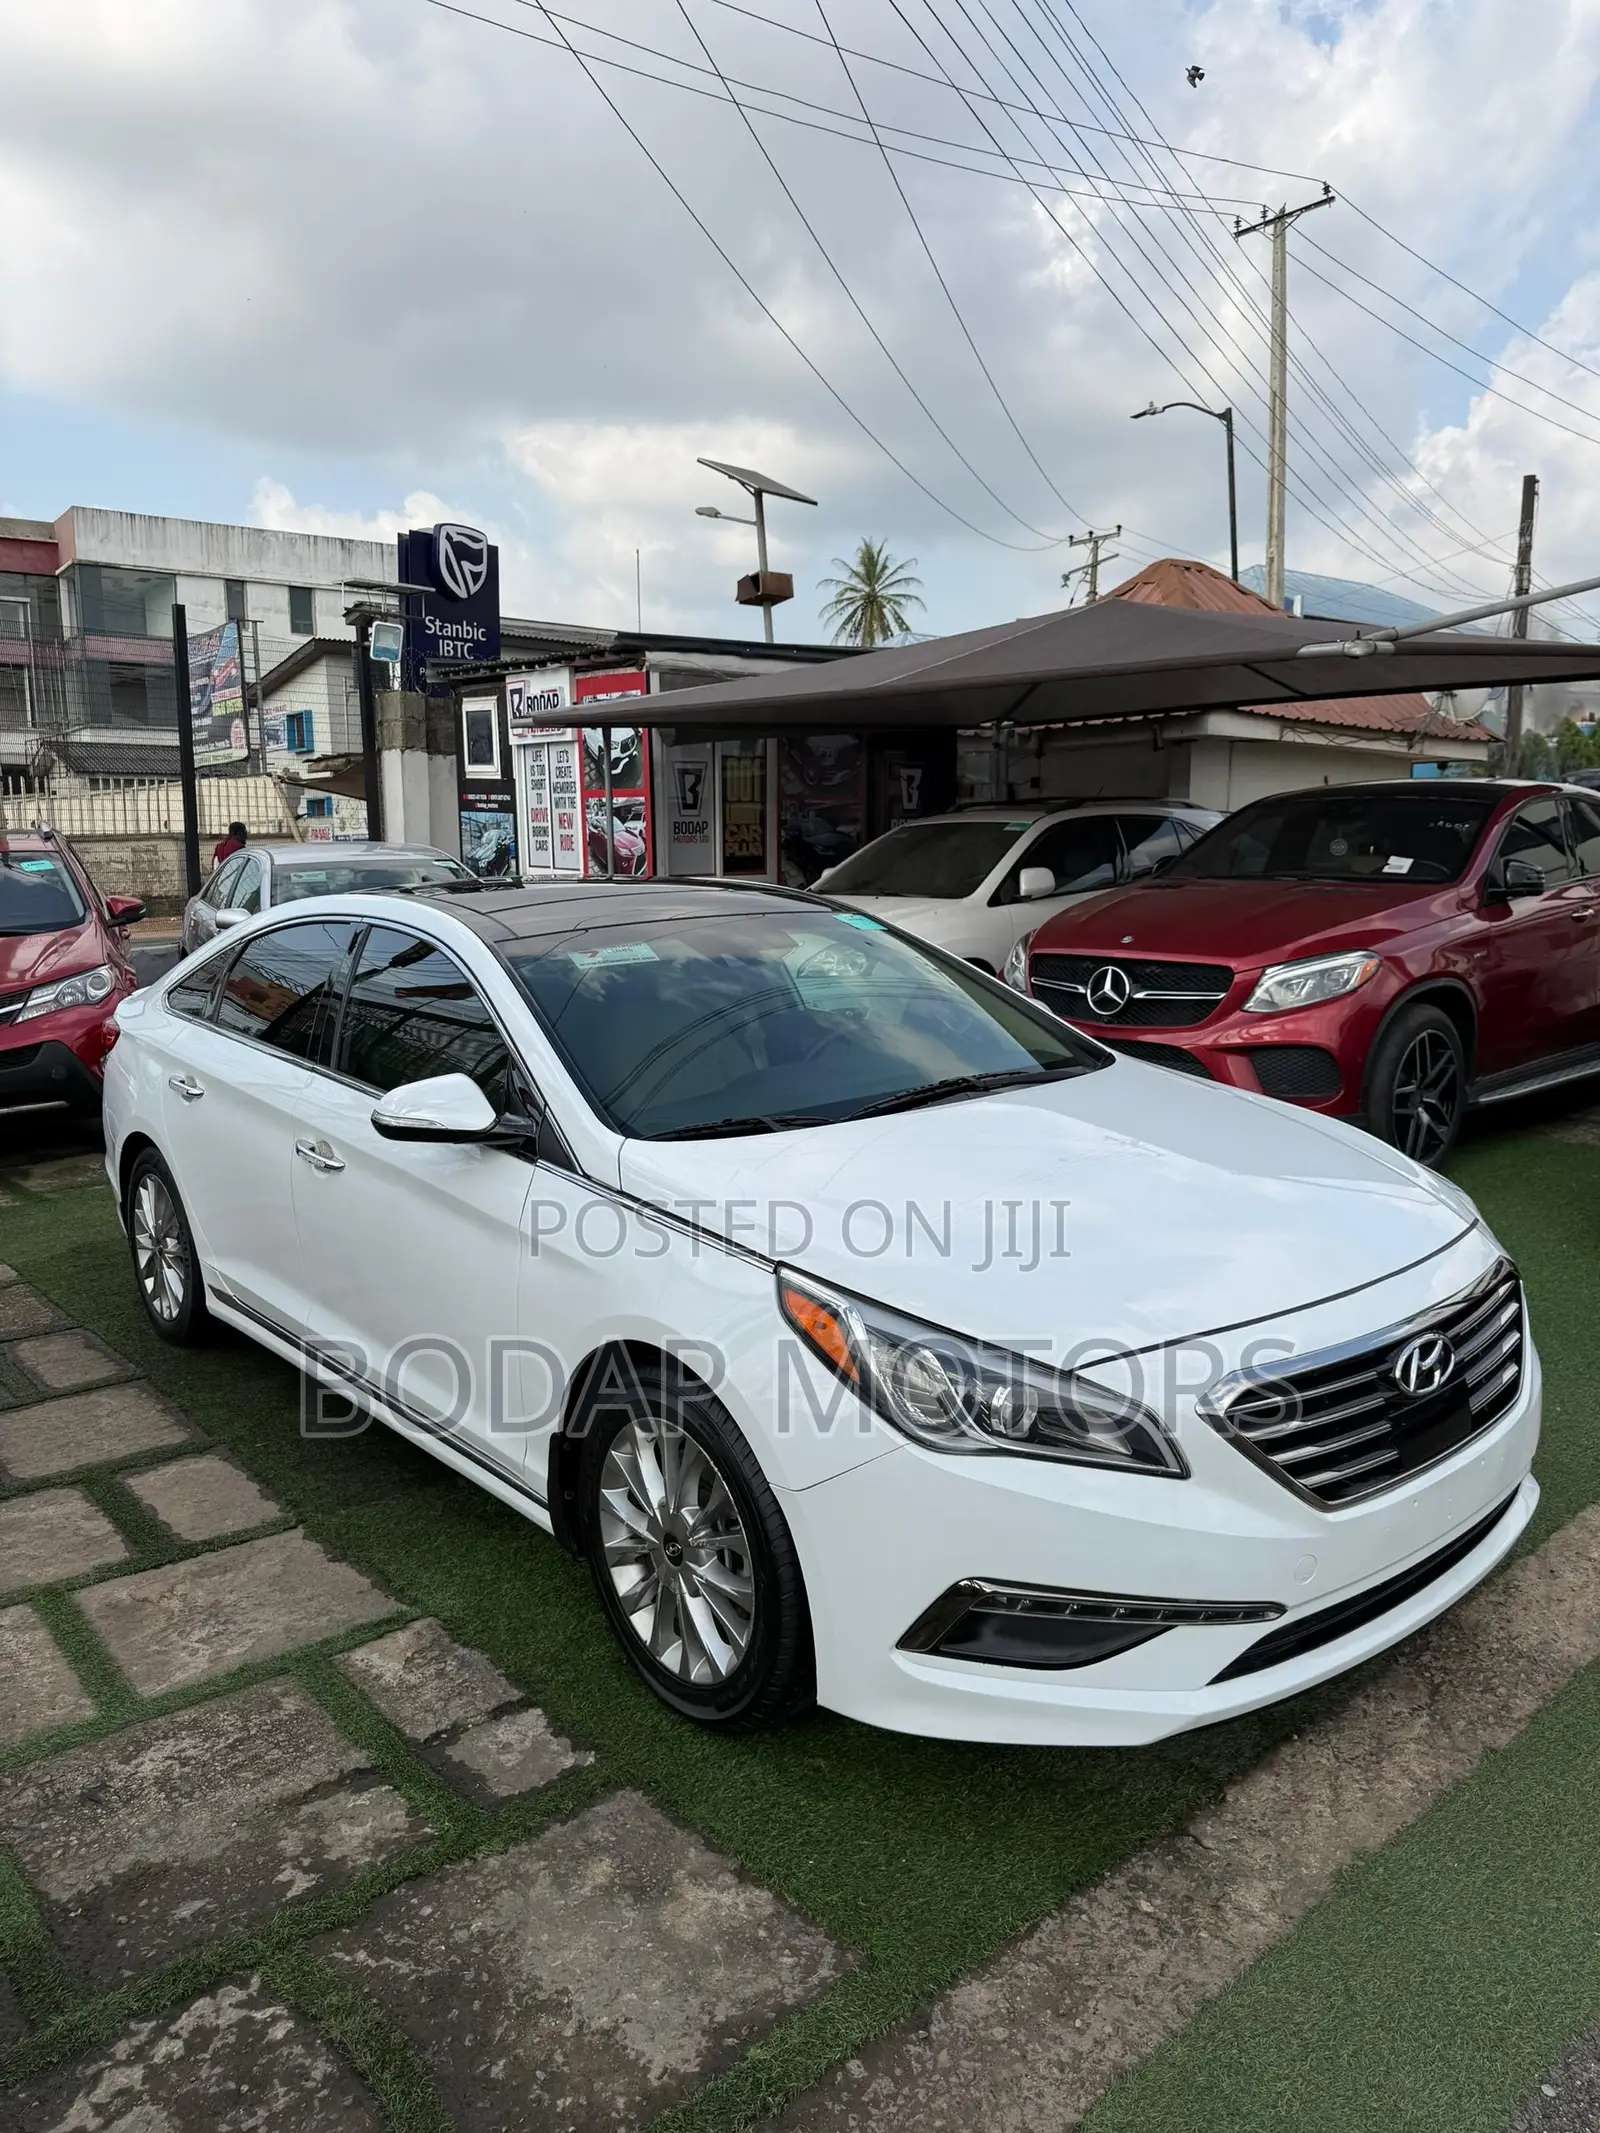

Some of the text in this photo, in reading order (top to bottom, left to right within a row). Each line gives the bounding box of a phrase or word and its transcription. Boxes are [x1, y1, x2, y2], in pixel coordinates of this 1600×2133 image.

[425, 616, 487, 641] Stanbic
[439, 639, 474, 660] IBTC
[531, 750, 542, 763] LIFE
[530, 764, 546, 777] IS TOO
[555, 766, 573, 779] CREATE
[531, 779, 546, 791] SHORT
[552, 781, 577, 794] MEMORIES
[536, 793, 543, 805] TO
[554, 796, 577, 809] WITH THE
[530, 807, 549, 823] DRIVE
[558, 812, 574, 830] NEW
[532, 826, 550, 838] BORING
[673, 821, 708, 835] BODAP
[535, 840, 549, 852] CARS
[560, 834, 574, 851] RIDE
[673, 835, 698, 844] MOTORS
